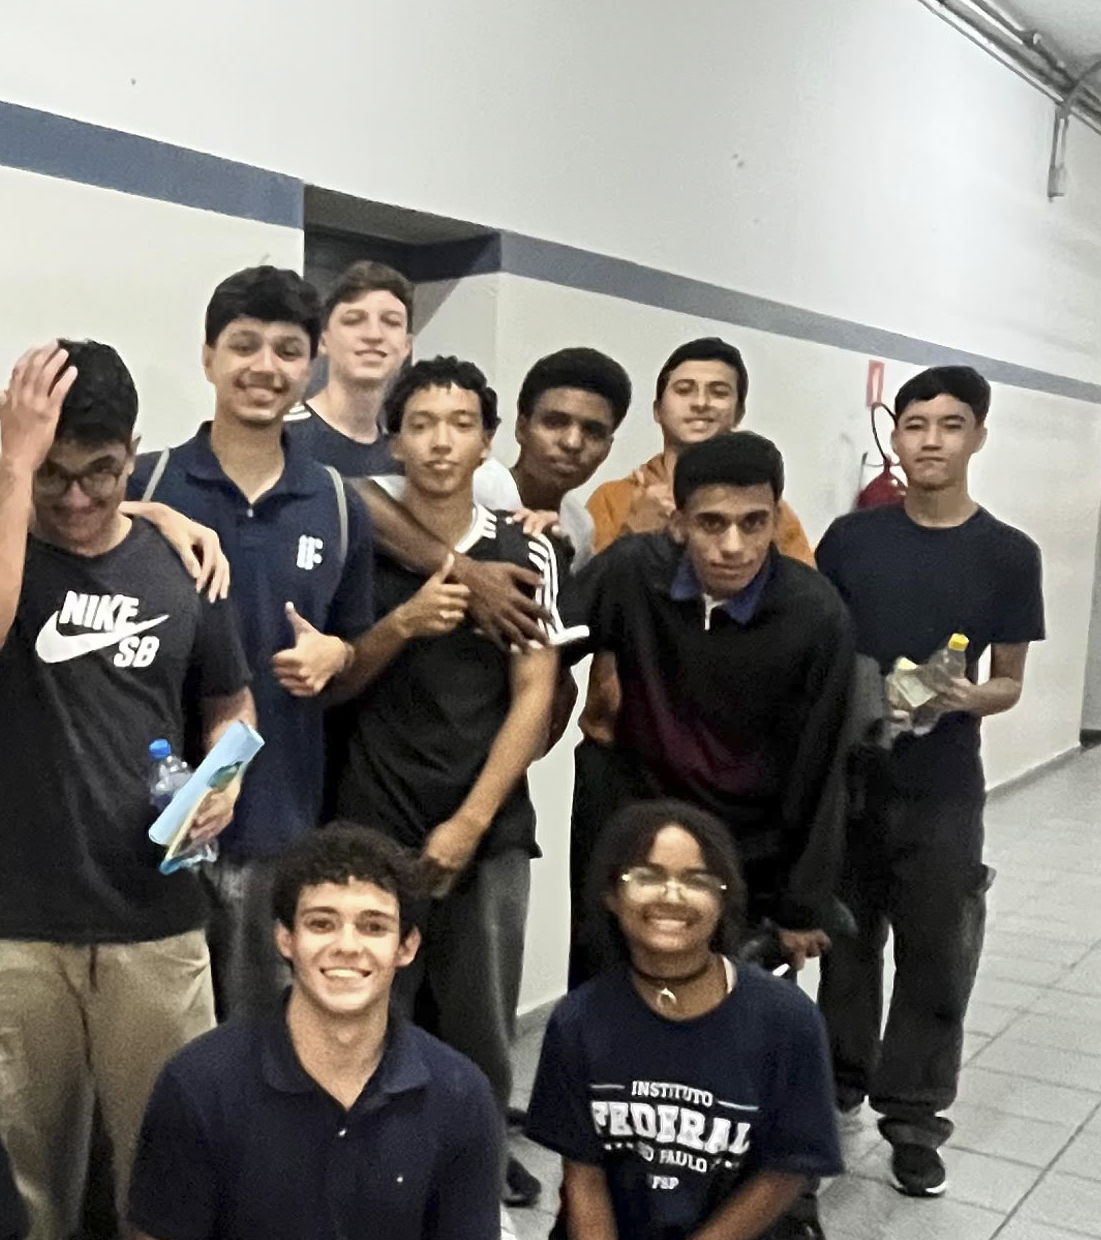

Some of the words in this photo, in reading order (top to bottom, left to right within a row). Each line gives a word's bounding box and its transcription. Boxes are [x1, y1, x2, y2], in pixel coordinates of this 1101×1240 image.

[58, 590, 139, 632] NIKE
[113, 635, 160, 668] SB
[631, 1080, 714, 1108] INSTITUTO
[659, 1149, 708, 1173] PAULO
